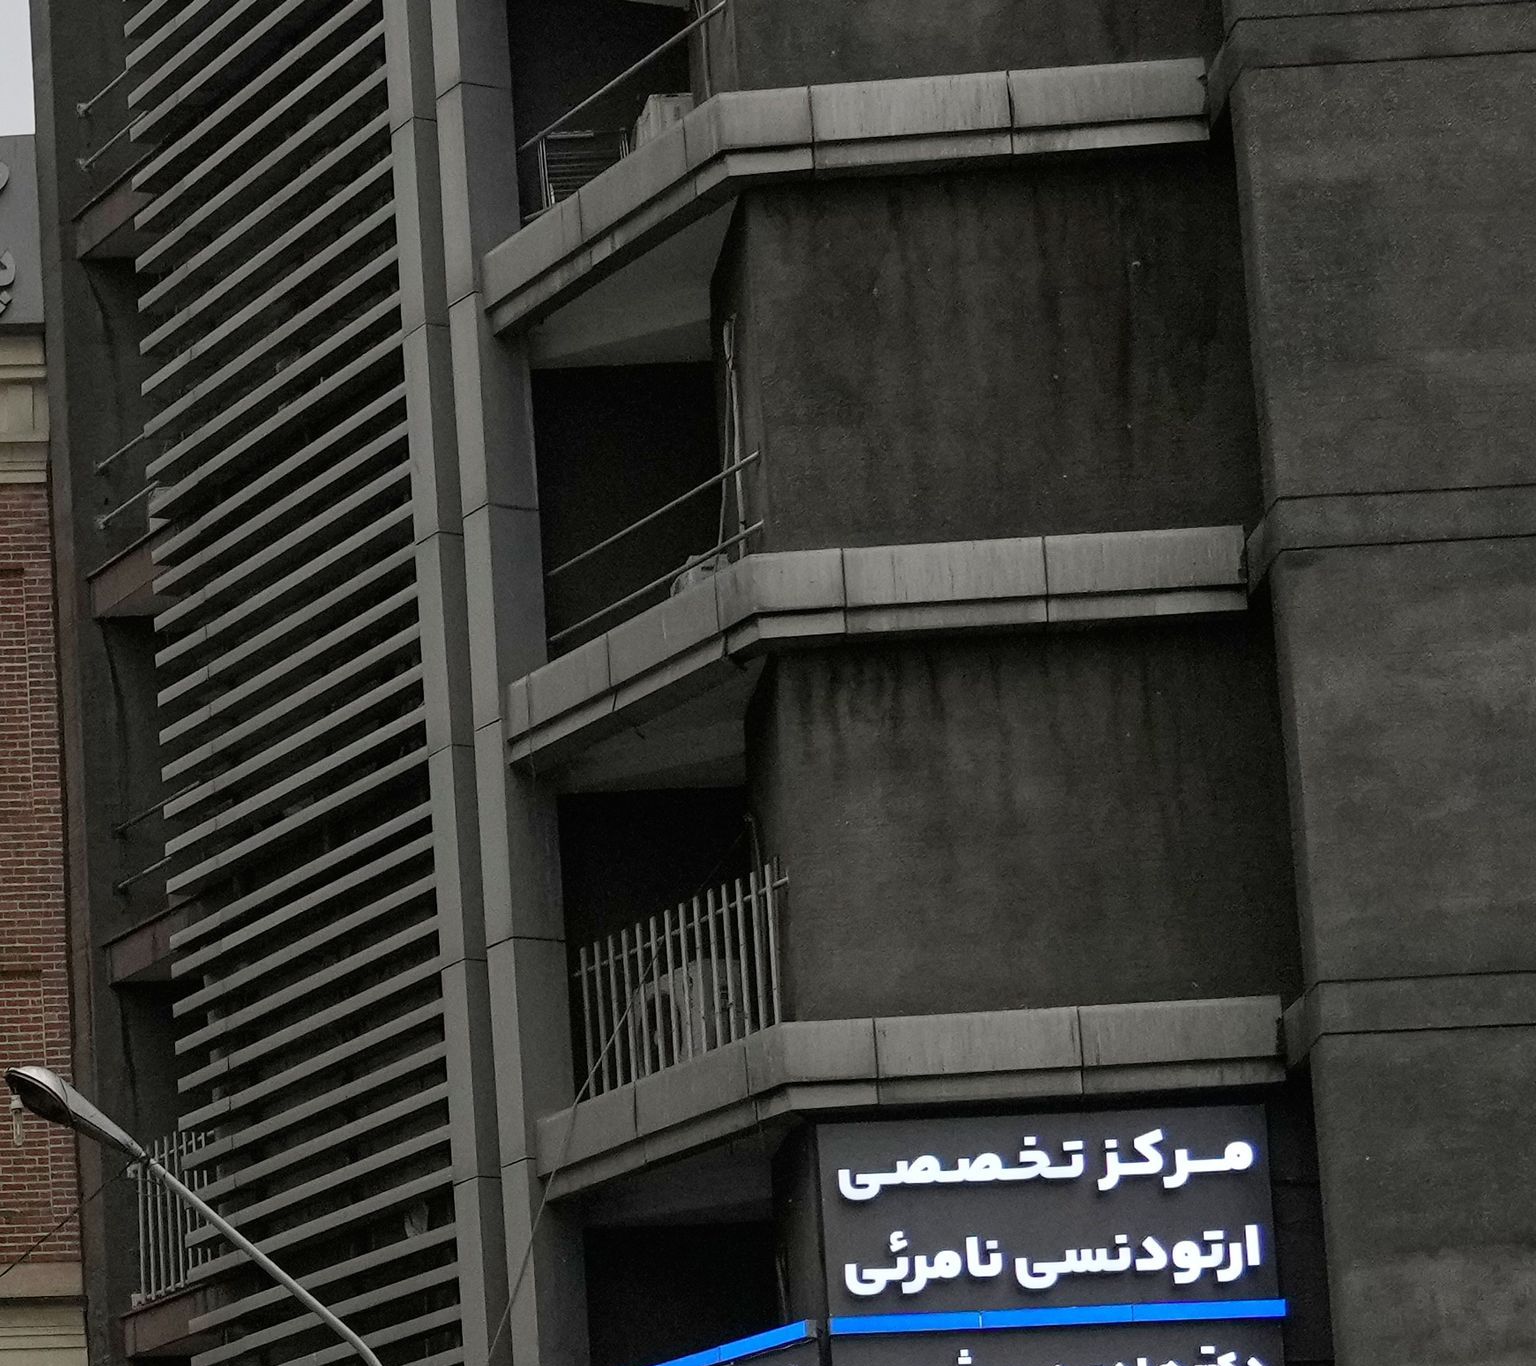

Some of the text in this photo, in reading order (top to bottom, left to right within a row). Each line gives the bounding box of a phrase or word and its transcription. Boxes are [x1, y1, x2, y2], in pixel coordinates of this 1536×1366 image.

[838, 1127, 1254, 1201] مرکز تخصصی
[845, 1224, 1261, 1296] ارتودنسی نامرئی
